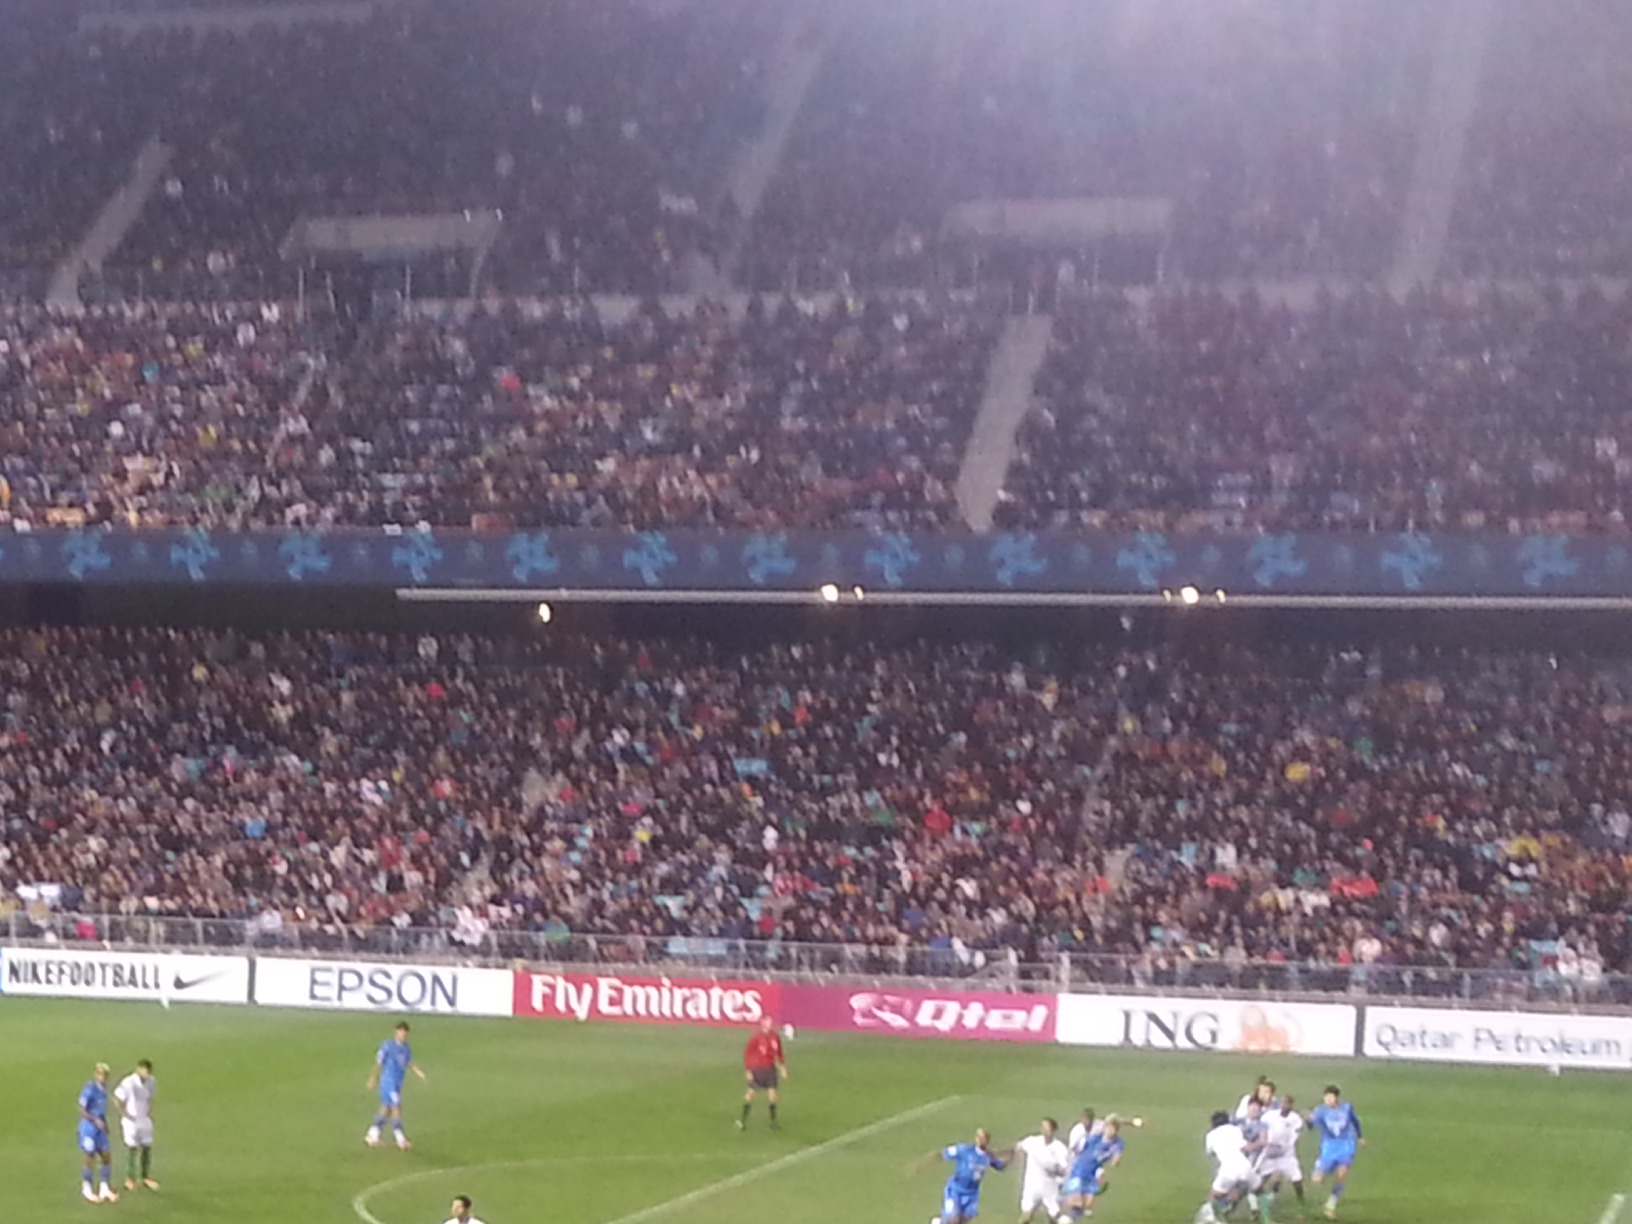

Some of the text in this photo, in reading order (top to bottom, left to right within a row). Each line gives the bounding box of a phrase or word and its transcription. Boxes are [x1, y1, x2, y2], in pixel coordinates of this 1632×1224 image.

[8, 958, 162, 990] NIKEFOOTBALL
[308, 967, 460, 1008] EPSON
[530, 973, 763, 1022] Fly Emirates
[916, 999, 1048, 1032] Qtel
[1119, 1009, 1221, 1049] ING
[1375, 1023, 1622, 1056] Qatar Petroleum
